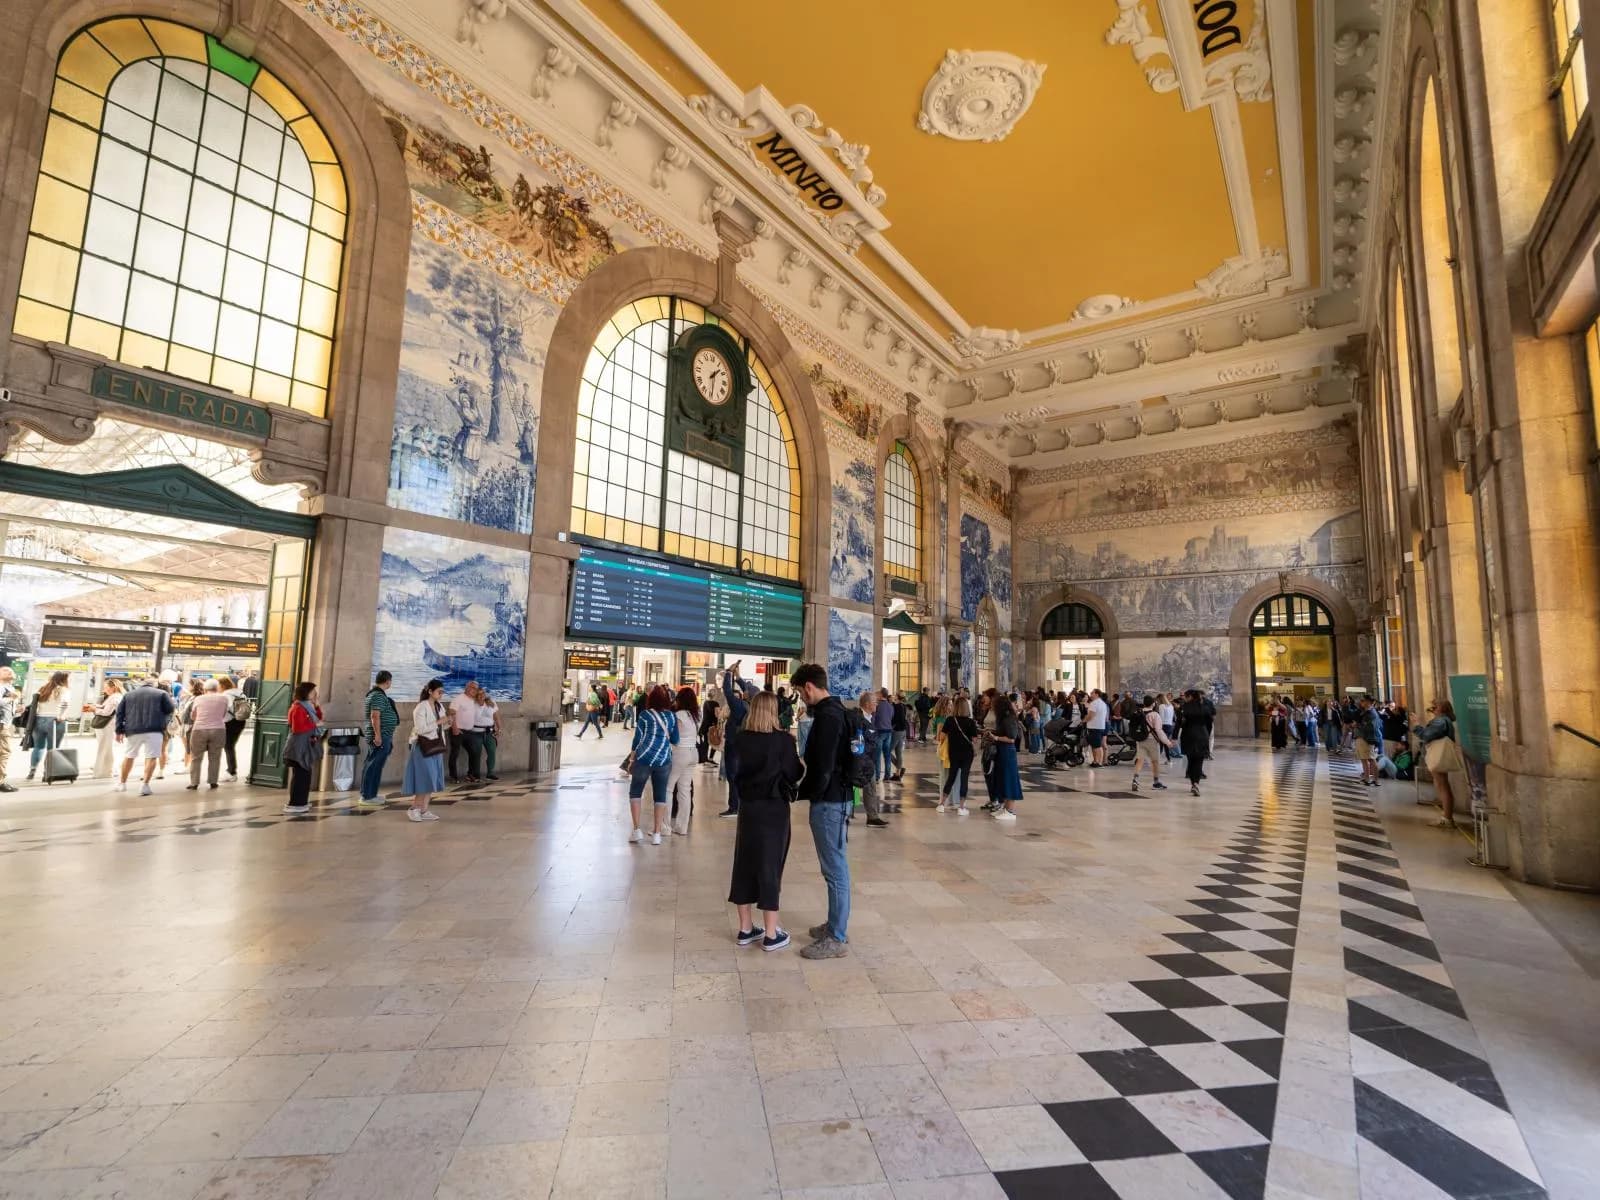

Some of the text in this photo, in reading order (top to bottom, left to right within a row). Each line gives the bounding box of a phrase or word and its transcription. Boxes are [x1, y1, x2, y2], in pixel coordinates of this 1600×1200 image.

[1194, 0, 1241, 58] DO
[756, 132, 843, 210] MINHO
[109, 373, 258, 430] ENTRADA
